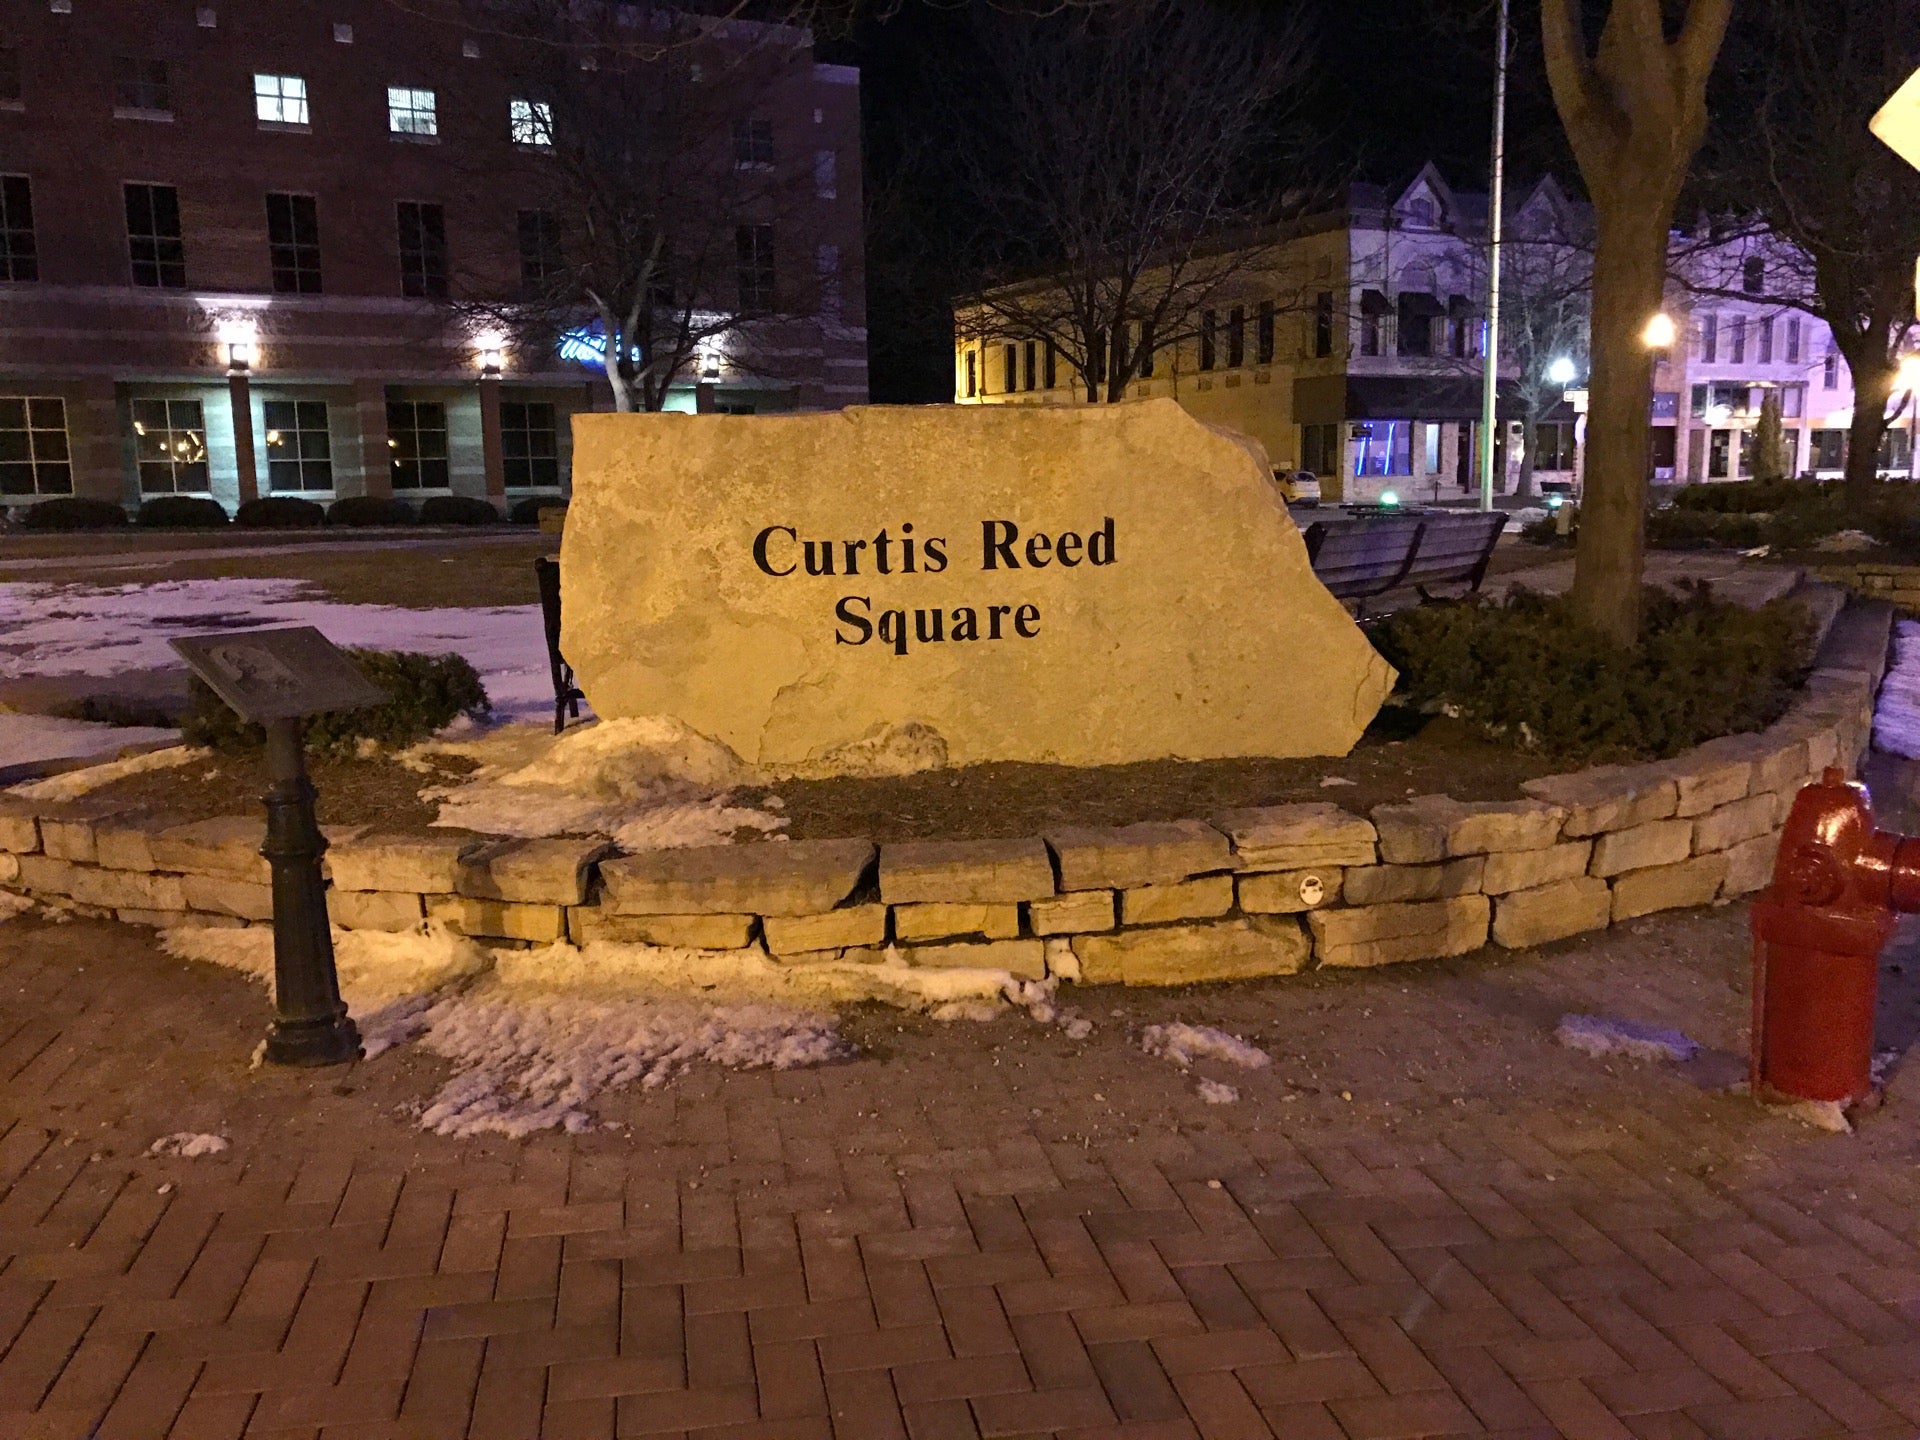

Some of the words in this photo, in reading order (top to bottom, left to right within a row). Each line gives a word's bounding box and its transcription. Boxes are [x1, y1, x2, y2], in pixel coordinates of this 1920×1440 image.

[752, 522, 949, 577] Curtis
[980, 516, 1118, 570] Reed
[835, 595, 1041, 656] Square
